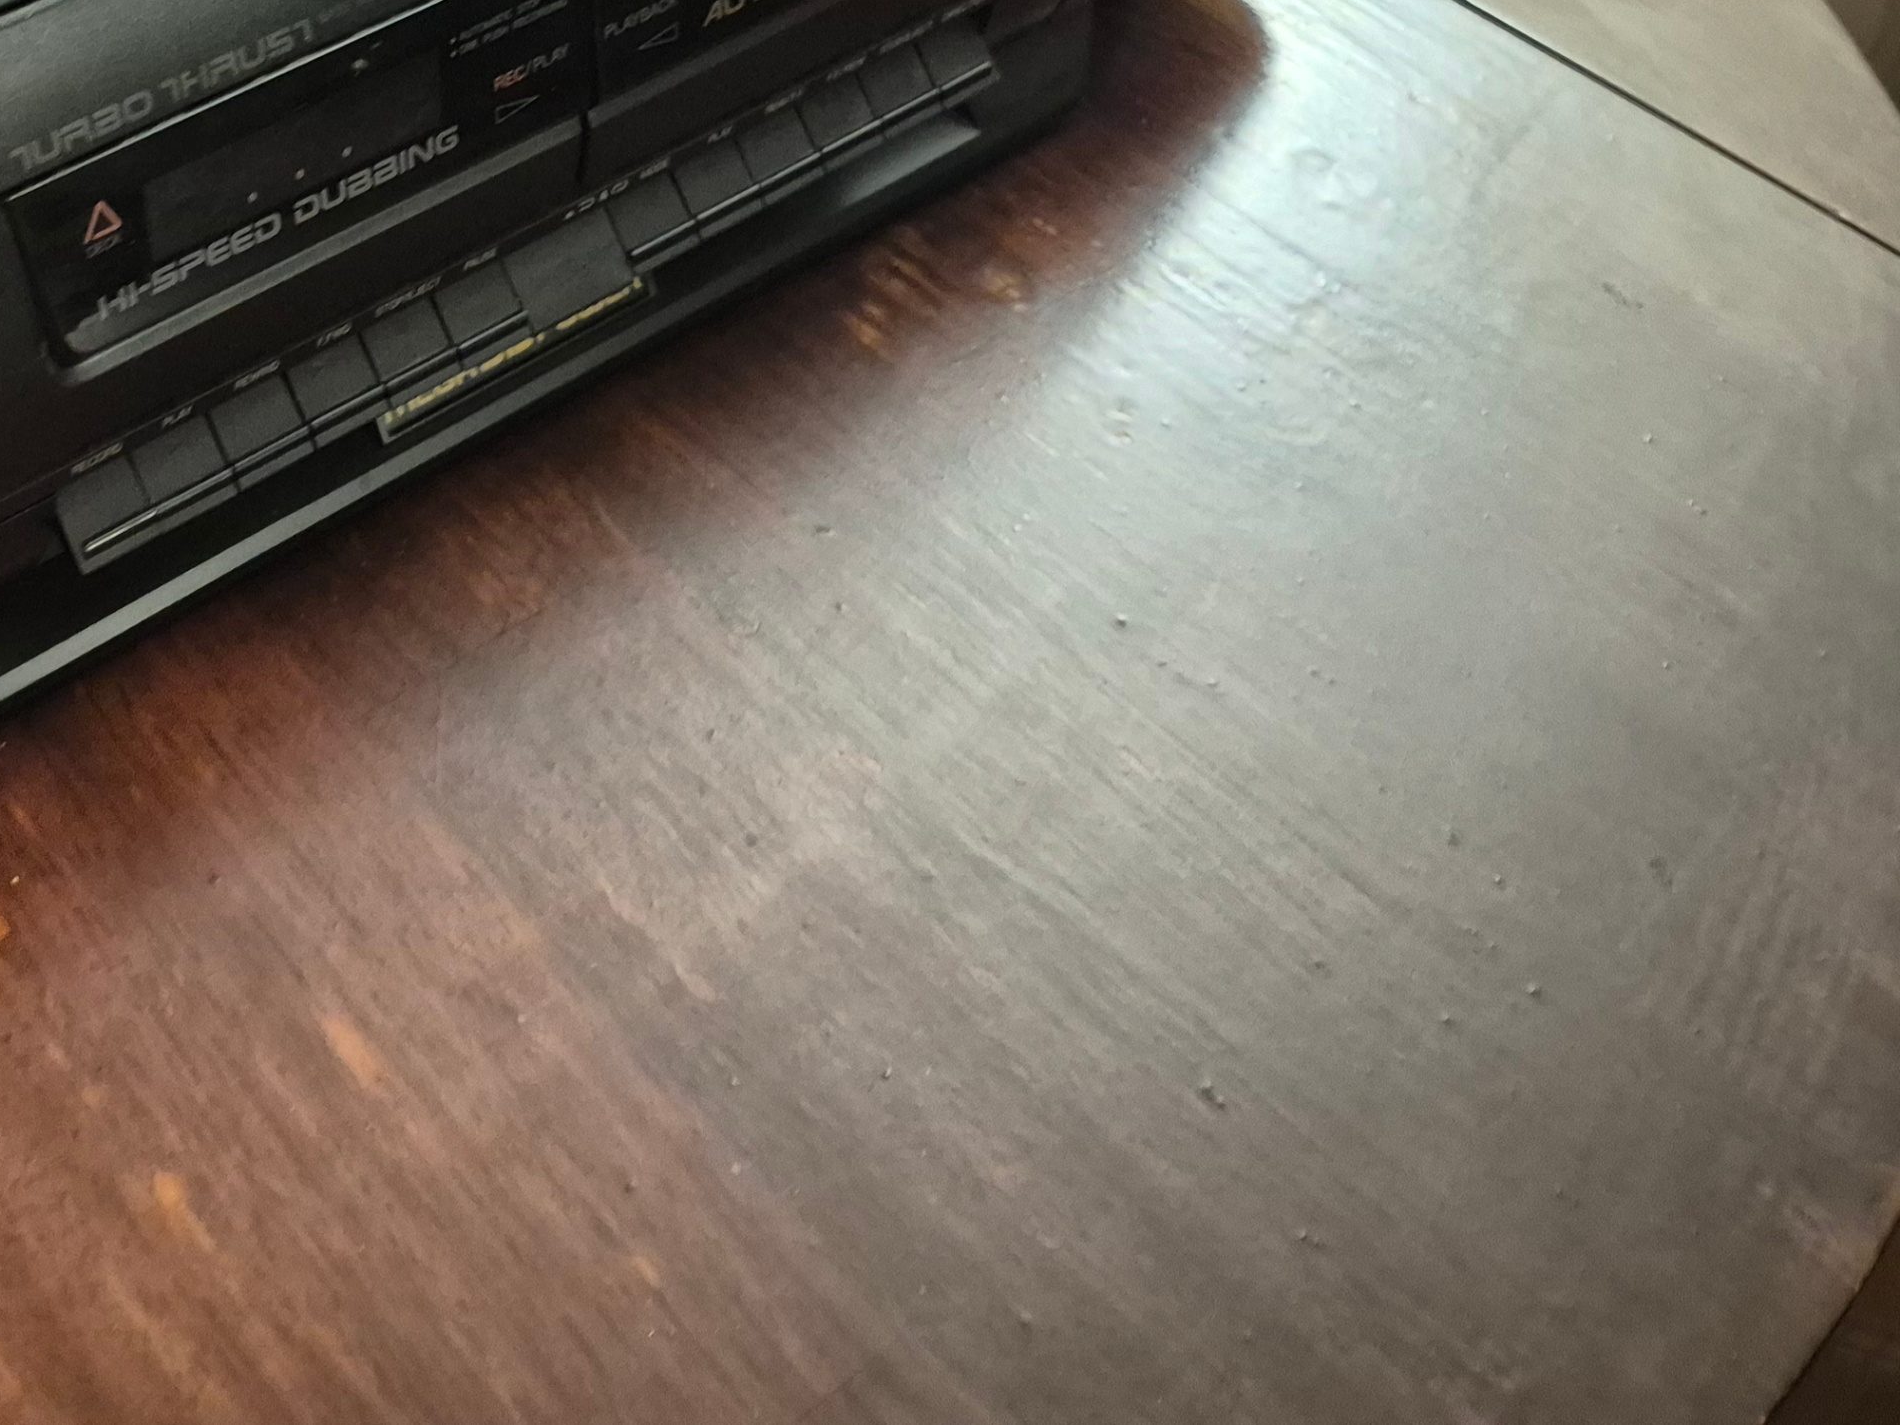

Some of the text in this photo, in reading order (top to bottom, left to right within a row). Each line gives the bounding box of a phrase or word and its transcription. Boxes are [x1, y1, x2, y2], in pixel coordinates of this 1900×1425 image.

[7, 90, 154, 173] TURBO
[160, 18, 315, 102] THRUST
[493, 42, 571, 92] REC/PLAY
[96, 124, 461, 321] HI-SPEED DUBBING
